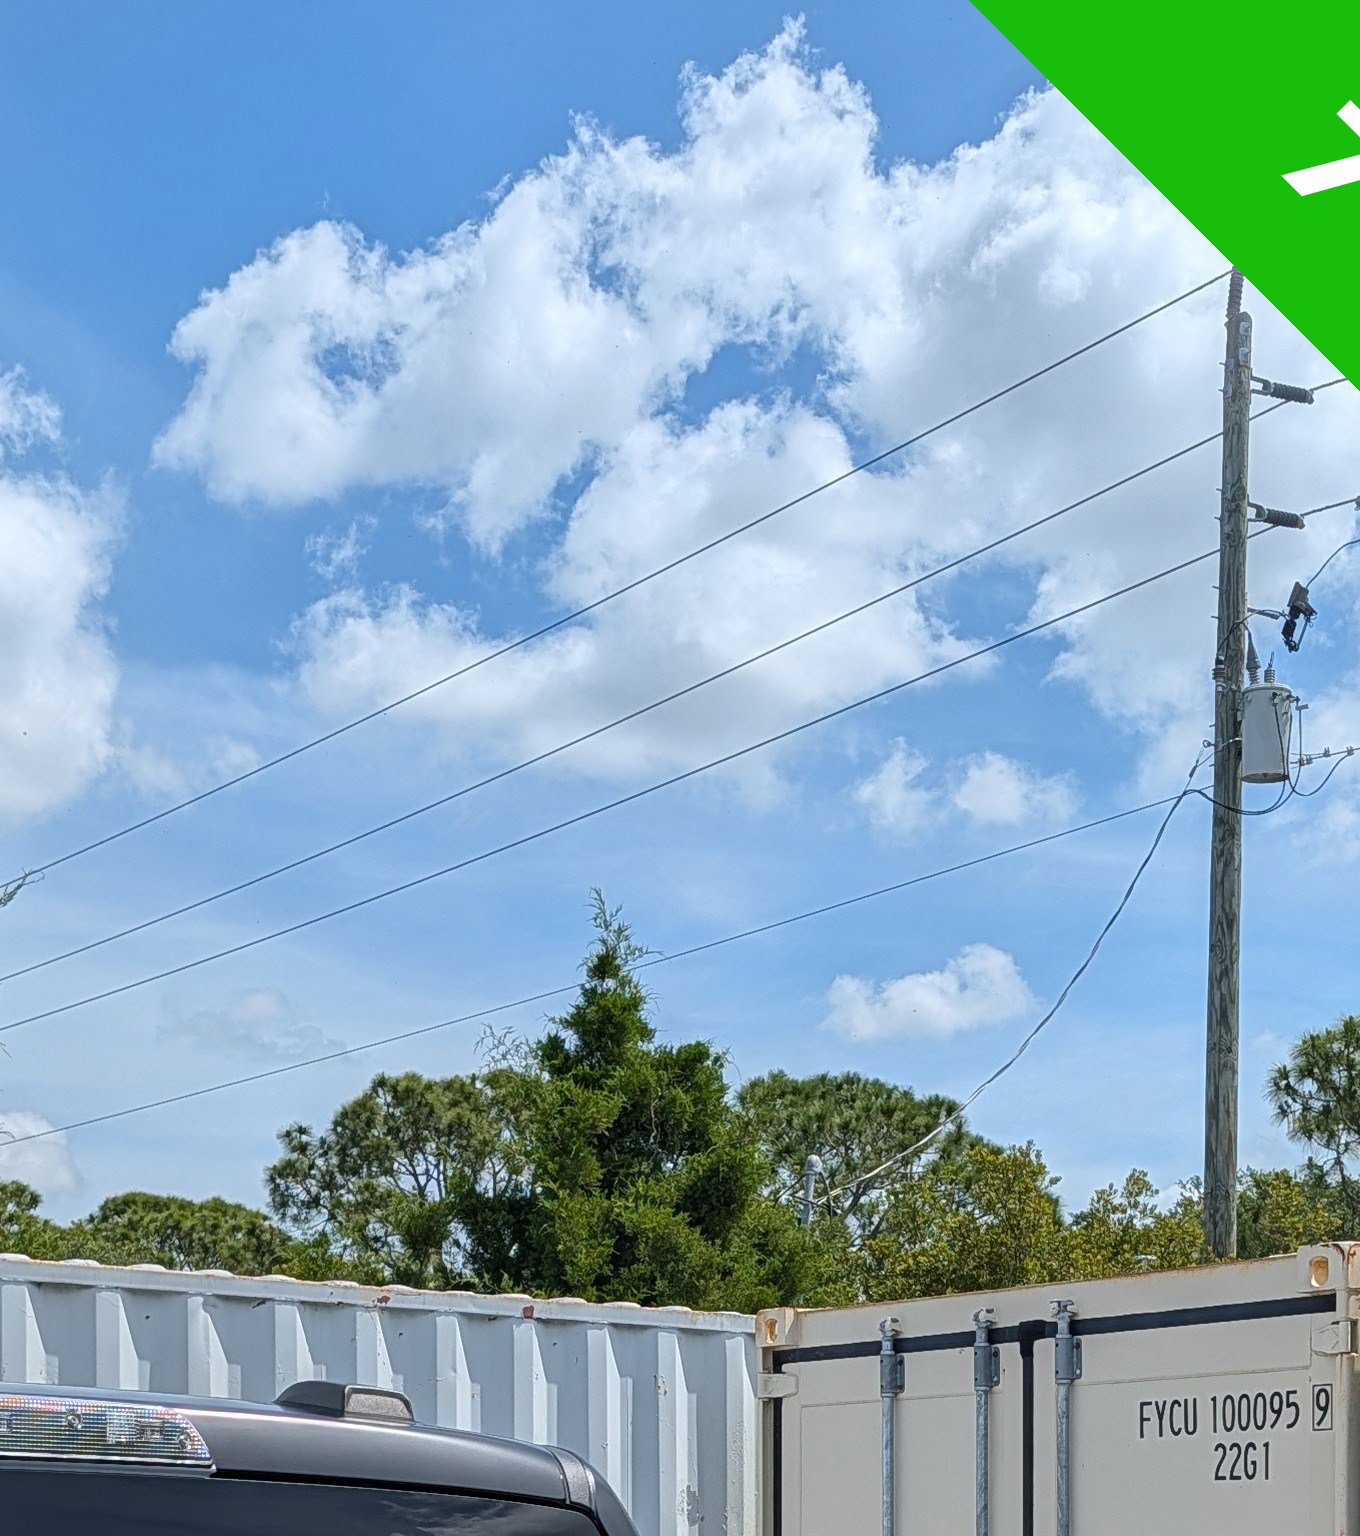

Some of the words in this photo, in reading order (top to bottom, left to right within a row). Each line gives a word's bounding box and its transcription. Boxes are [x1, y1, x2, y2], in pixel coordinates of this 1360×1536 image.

[1139, 1397, 1197, 1438] FYCU
[1210, 1390, 1300, 1433] 100095
[1315, 1388, 1330, 1427] 9
[1213, 1441, 1270, 1480] 22G1
